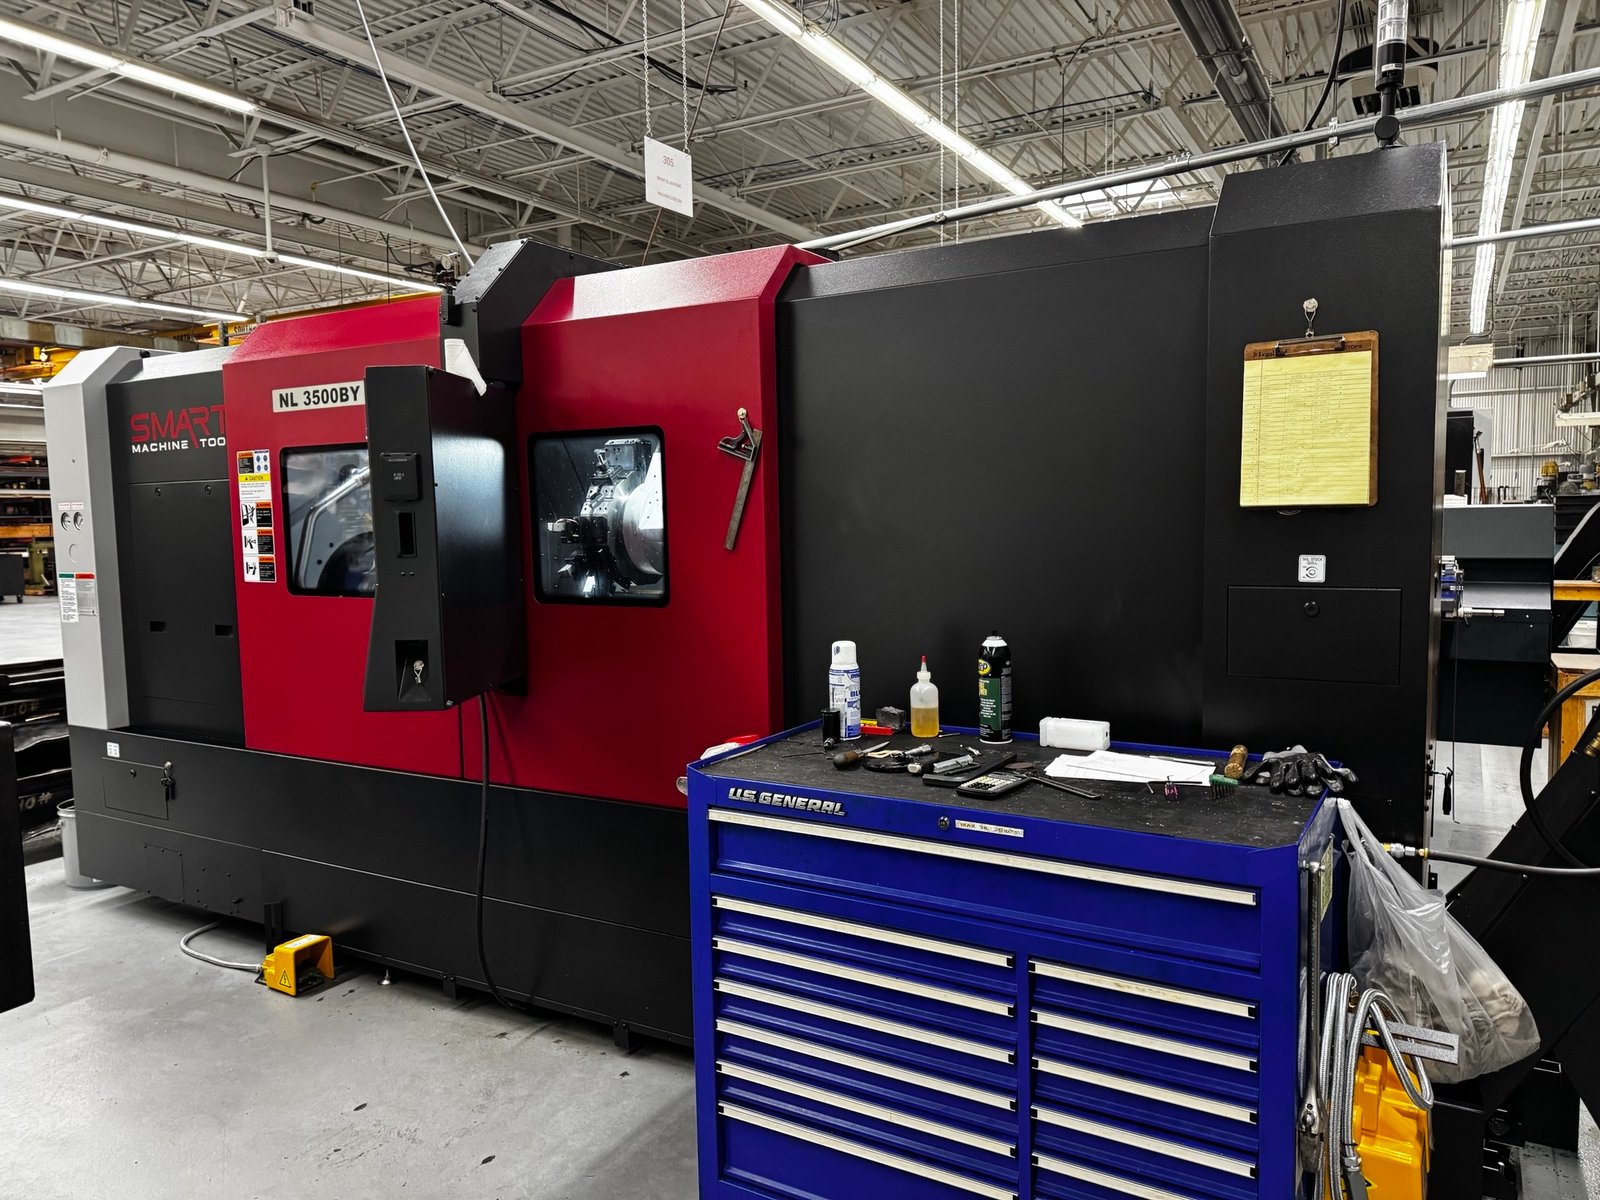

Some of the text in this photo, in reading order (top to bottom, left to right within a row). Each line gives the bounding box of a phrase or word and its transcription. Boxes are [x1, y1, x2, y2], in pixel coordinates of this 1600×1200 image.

[662, 155, 675, 167] 305
[279, 385, 361, 409] NL 3500BY
[130, 404, 226, 447] SMART
[131, 436, 227, 454] MACHINE TOO
[758, 791, 846, 817] GENERAL
